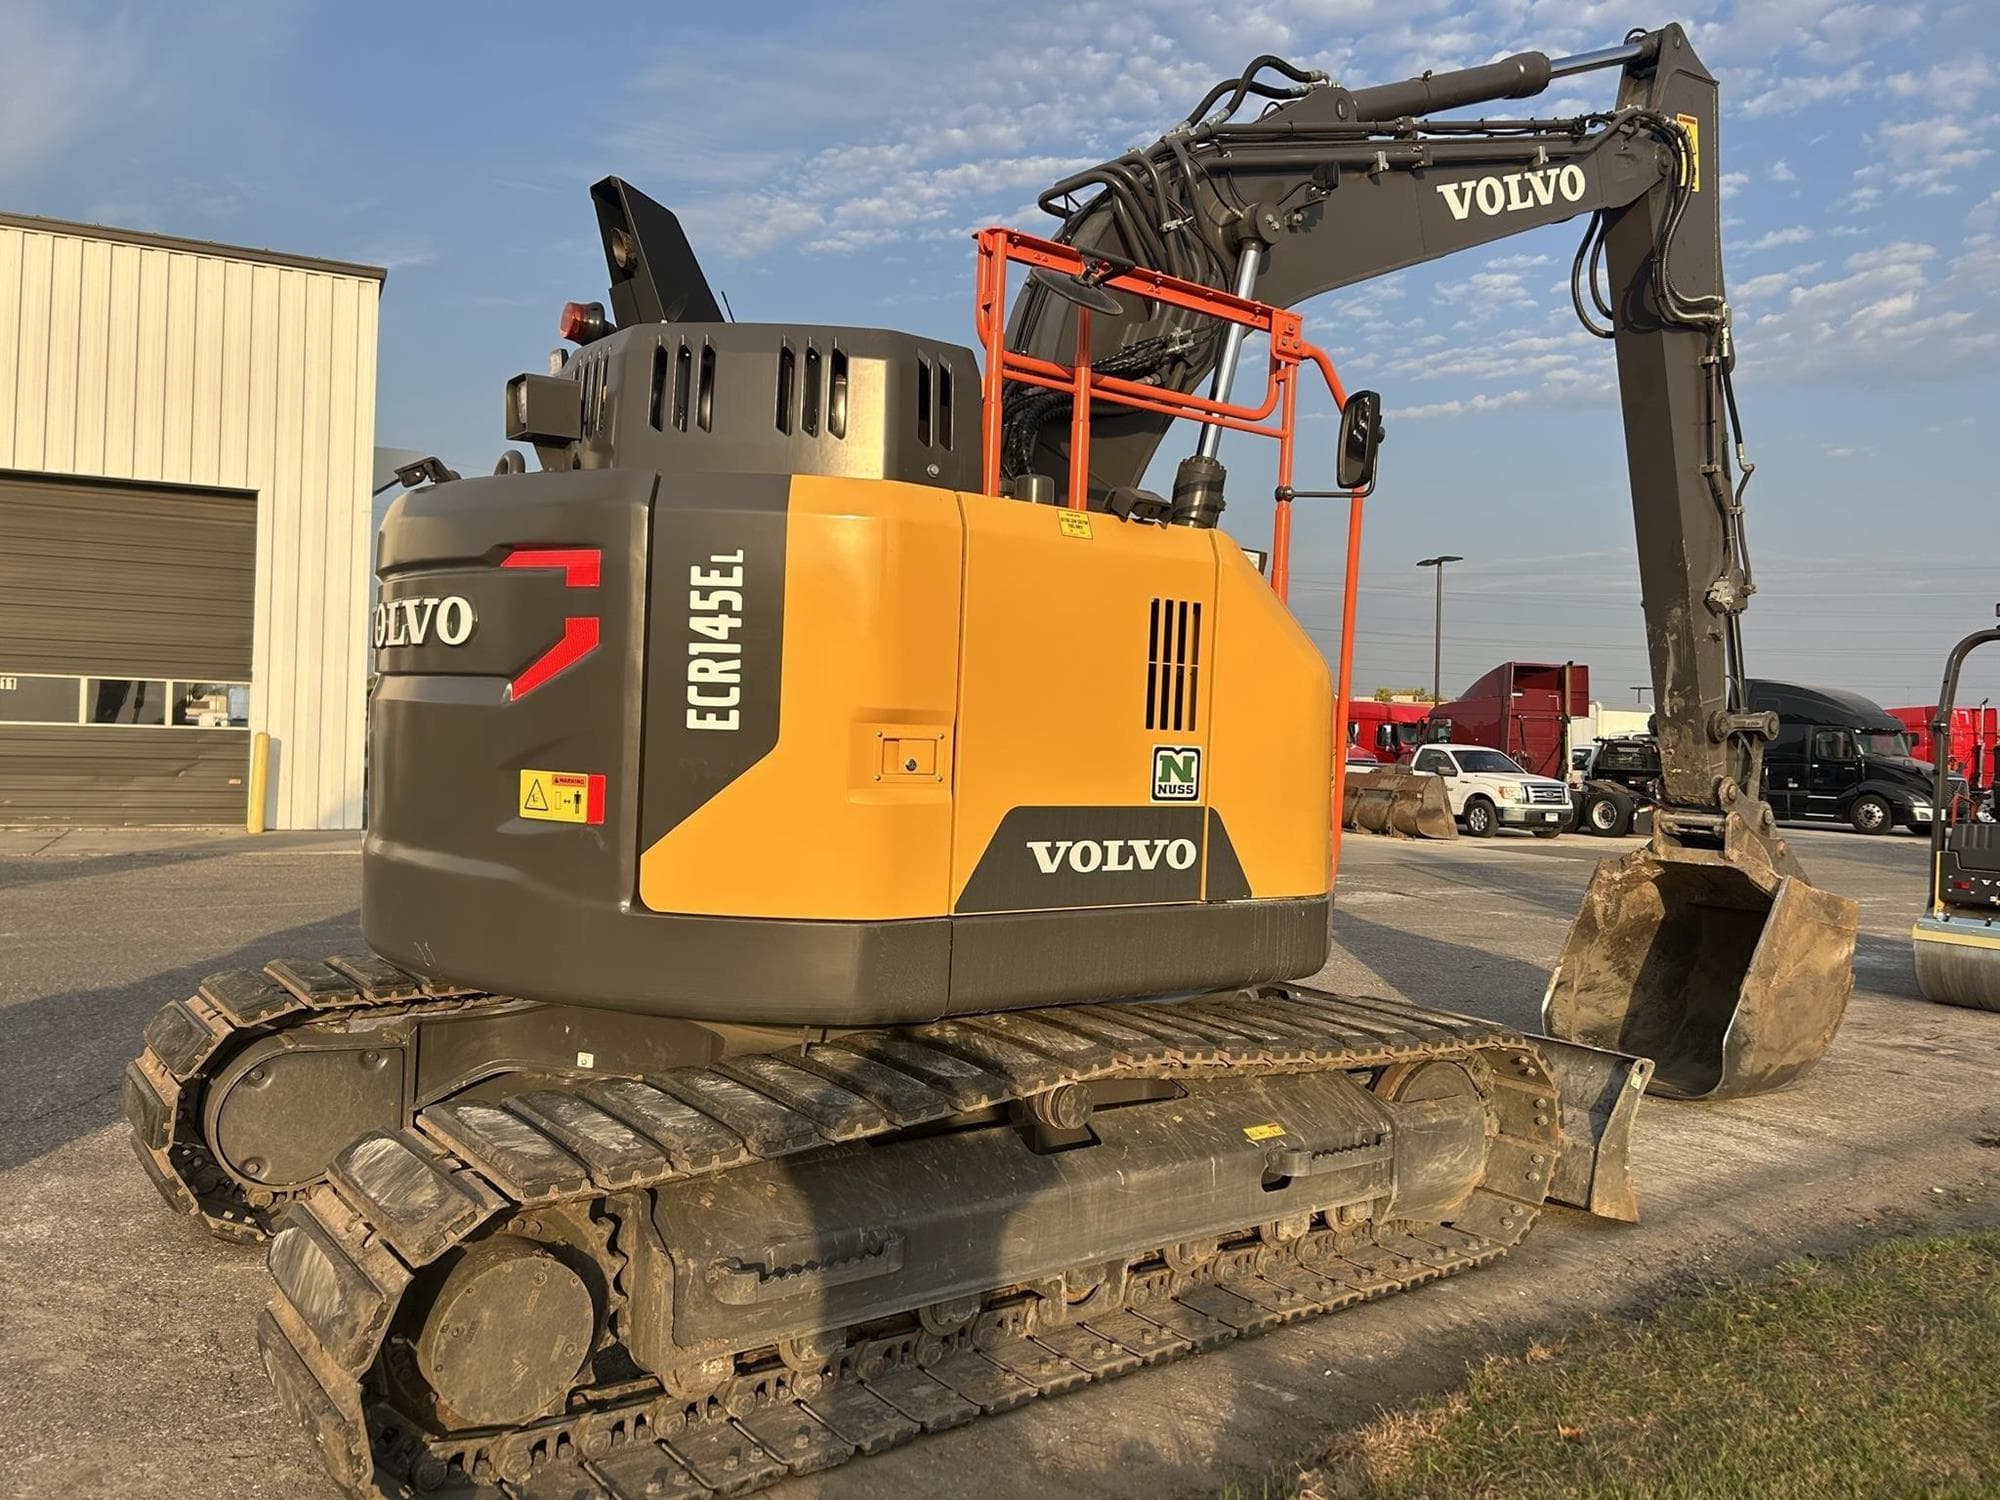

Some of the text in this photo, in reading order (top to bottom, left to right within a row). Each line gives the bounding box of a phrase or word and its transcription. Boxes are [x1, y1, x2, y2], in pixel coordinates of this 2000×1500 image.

[1436, 164, 1586, 221] VOLVO
[373, 596, 473, 648] OLVO
[686, 549, 744, 731] ECR145EL
[559, 777, 584, 785] WARNING
[1158, 755, 1195, 783] N
[1157, 784, 1194, 794] NUSS
[1026, 838, 1197, 874] VOLVO
